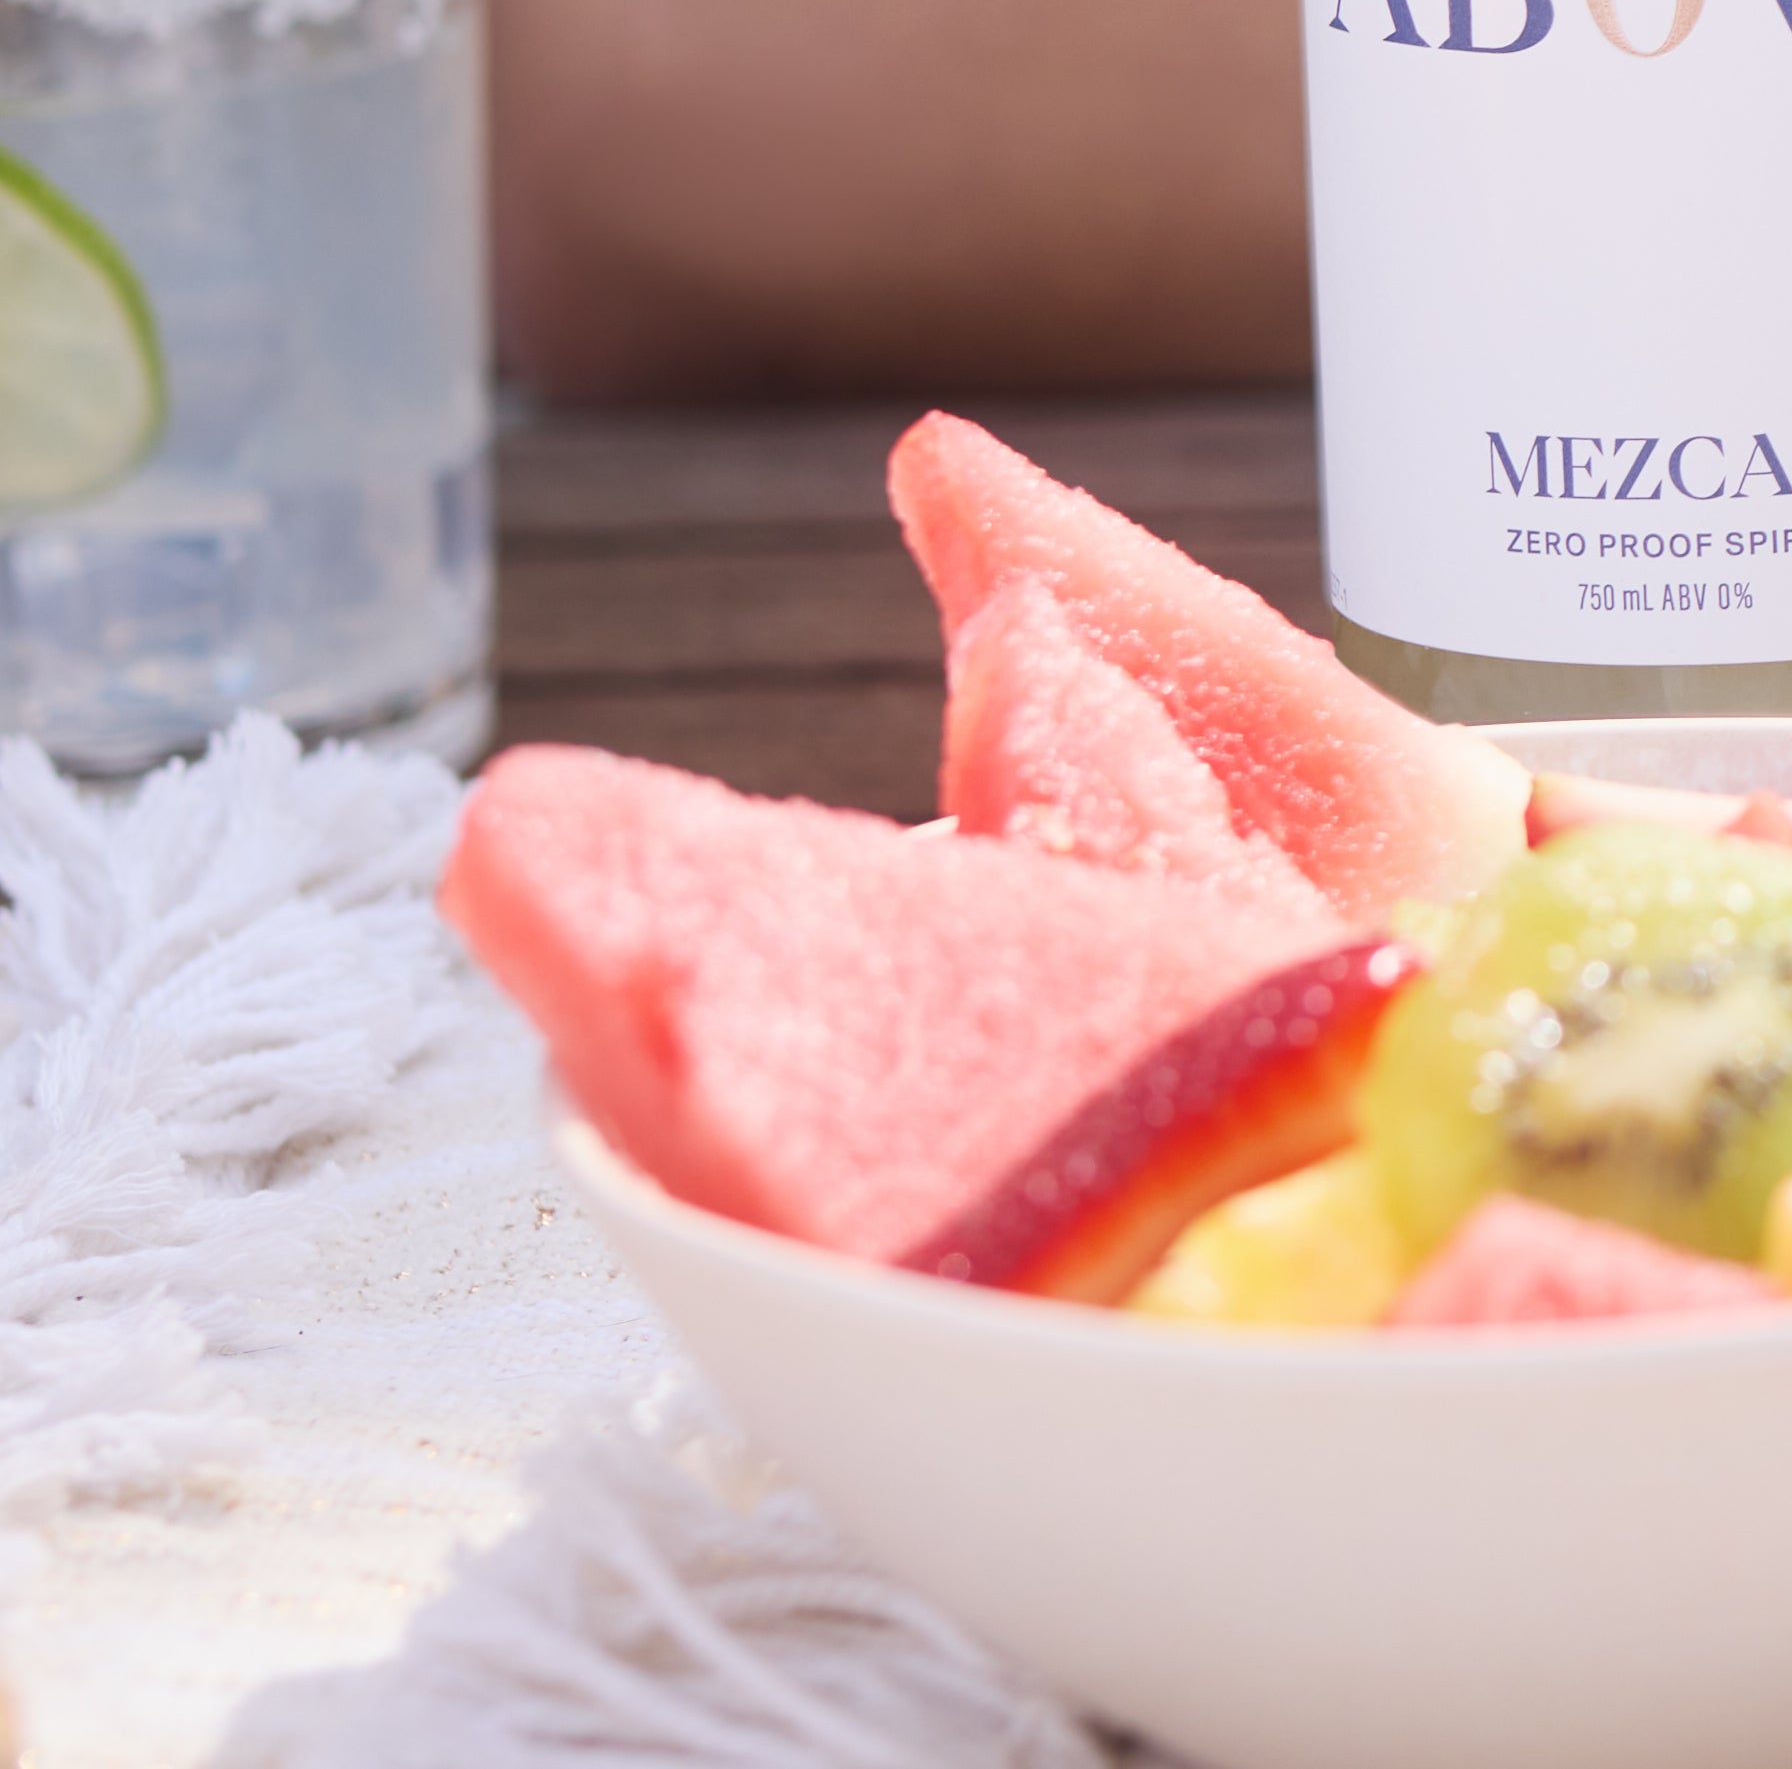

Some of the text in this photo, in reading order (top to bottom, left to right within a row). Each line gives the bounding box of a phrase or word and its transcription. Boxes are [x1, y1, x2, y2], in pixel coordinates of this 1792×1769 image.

[1506, 528, 1586, 557] ZERO
[1599, 533, 1713, 559] PROOF
[1578, 581, 1753, 612] 750 mL ABV 0%
